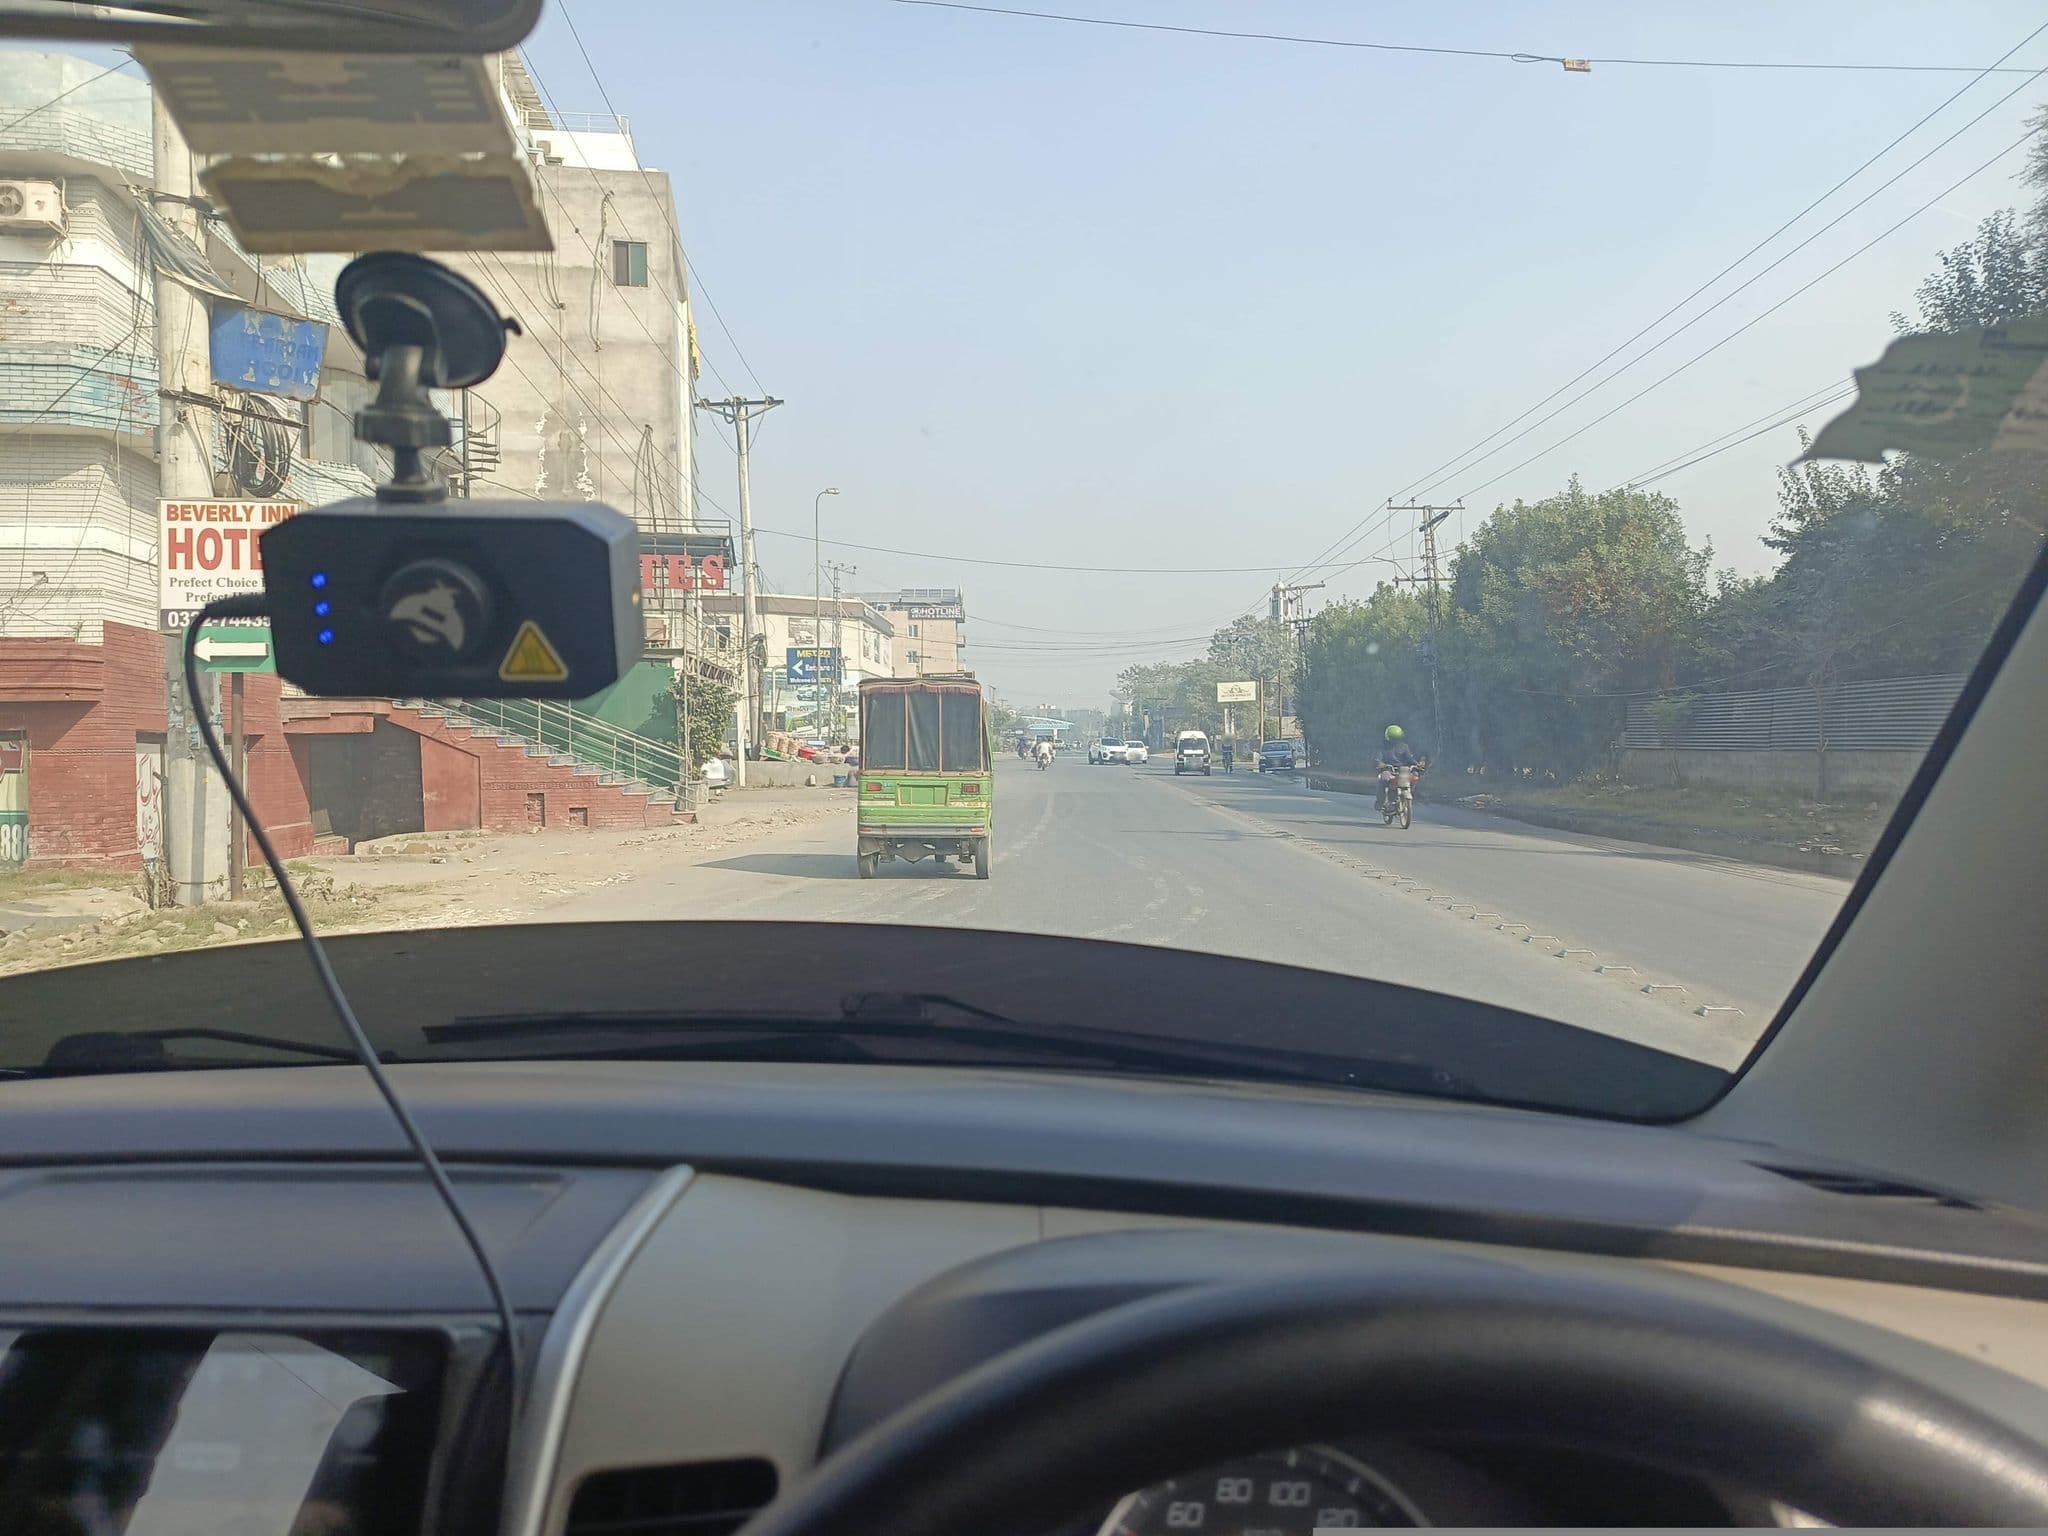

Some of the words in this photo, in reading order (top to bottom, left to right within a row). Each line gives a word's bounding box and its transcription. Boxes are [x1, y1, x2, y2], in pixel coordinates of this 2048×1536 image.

[166, 504, 255, 522] BEVERLY
[261, 505, 295, 522] INN
[168, 528, 267, 570] HOTE
[169, 577, 212, 587] Prefect
[216, 577, 258, 587] Choice
[921, 607, 961, 615] HOTLINE
[1216, 1477, 1253, 1502] 80
[1166, 1502, 1204, 1527] 60
